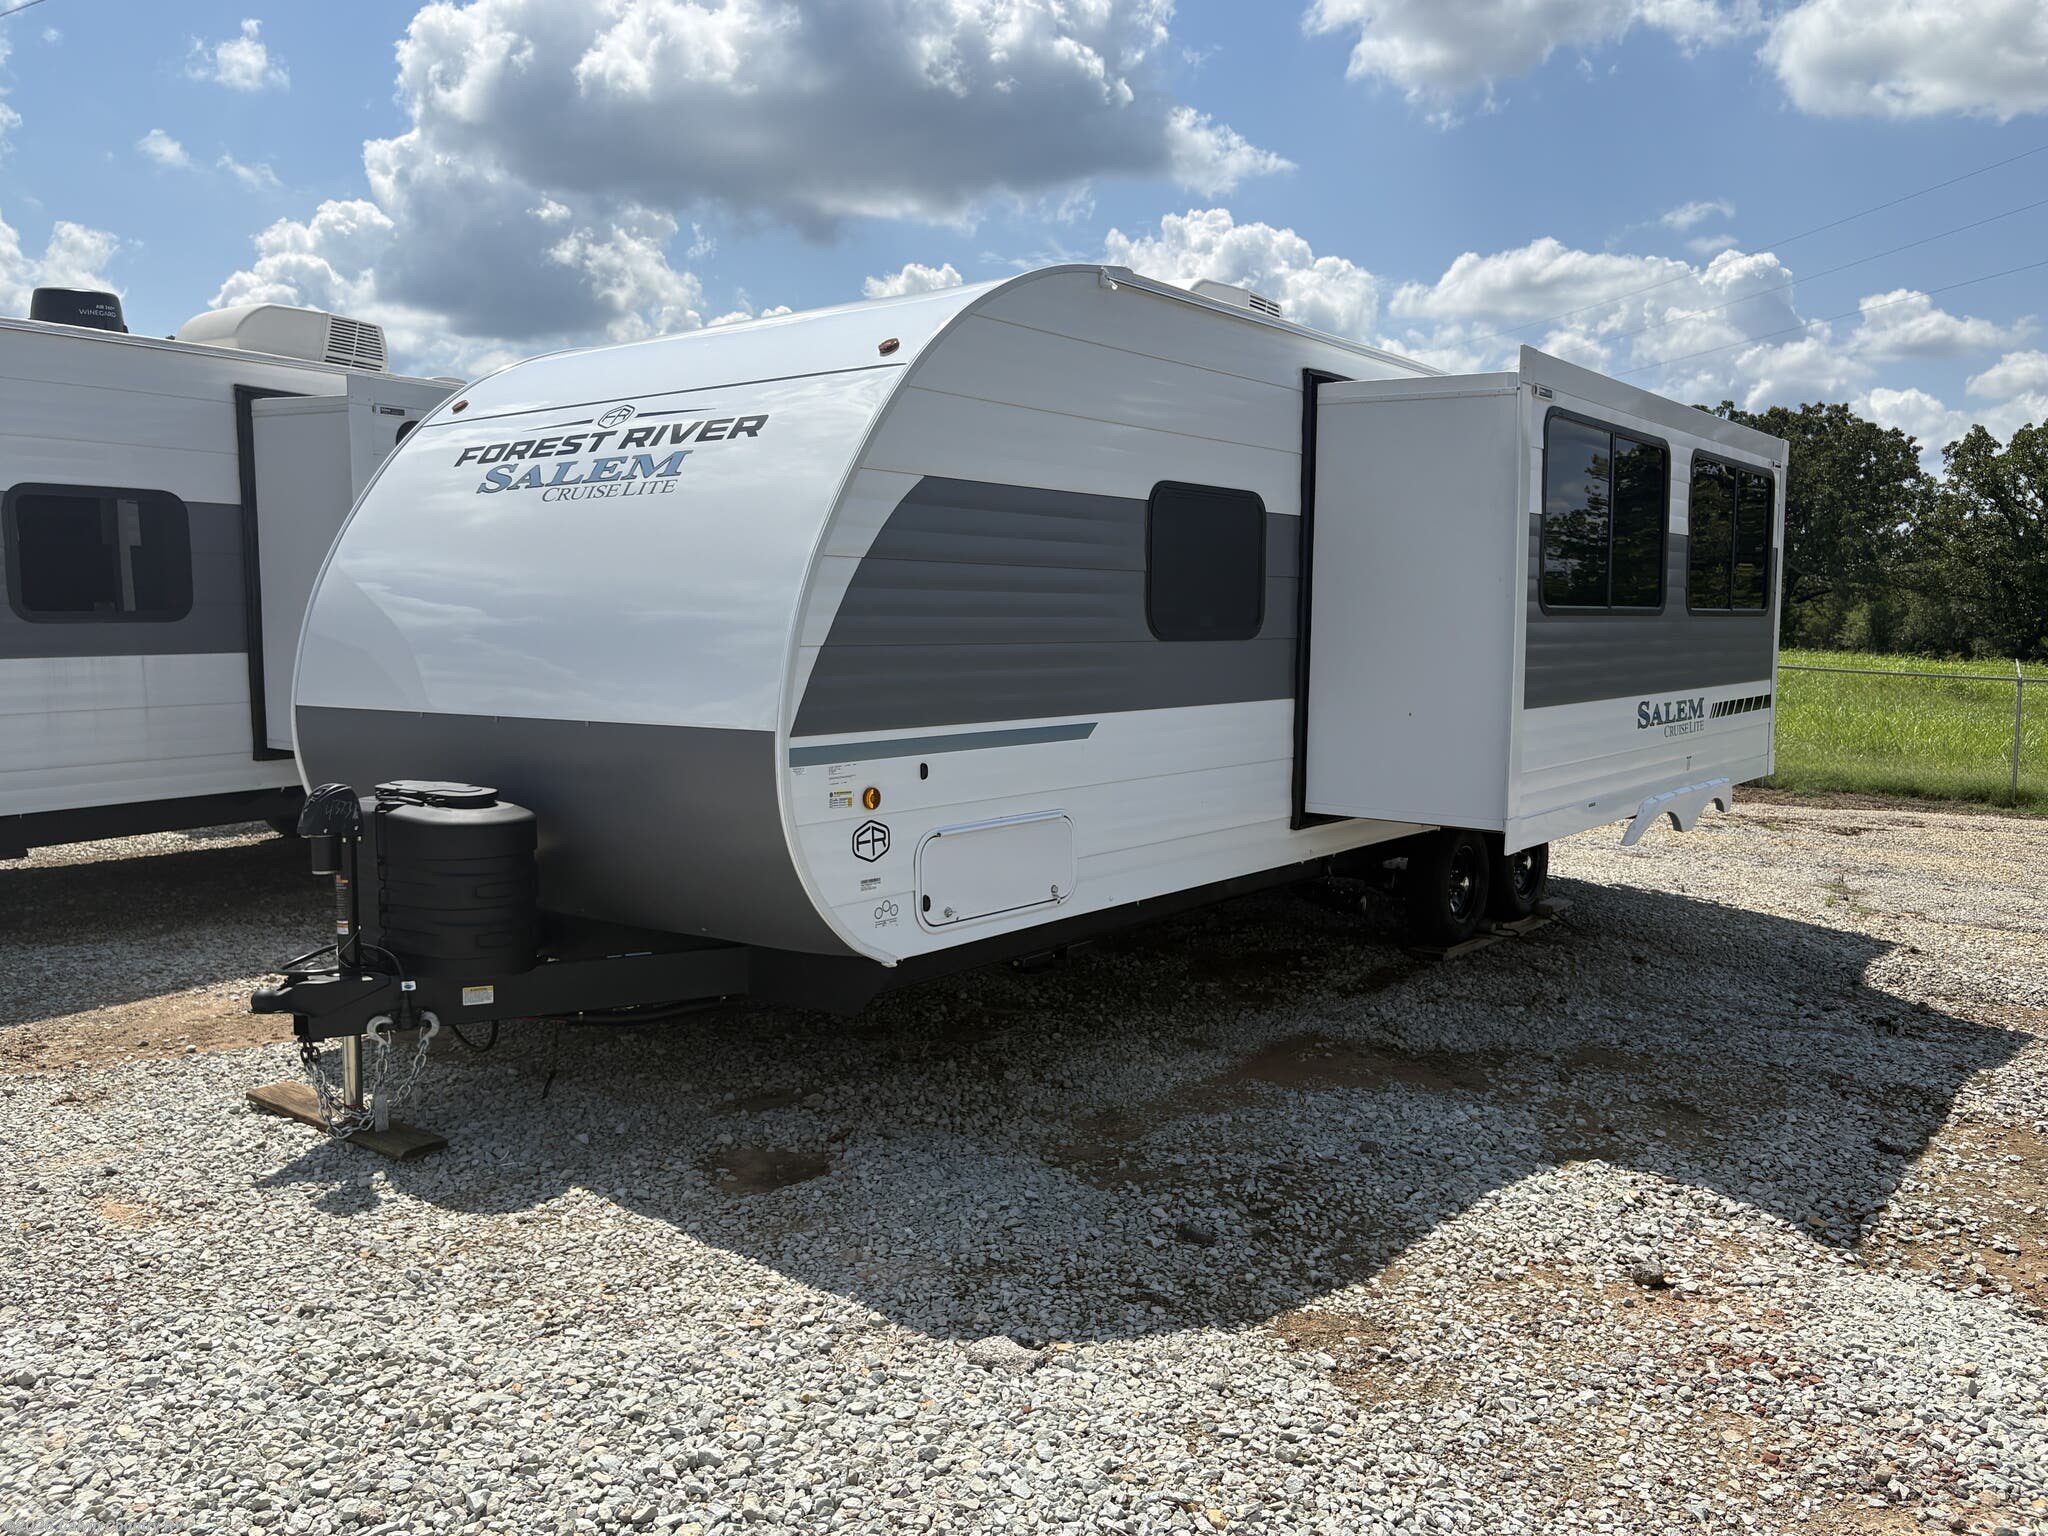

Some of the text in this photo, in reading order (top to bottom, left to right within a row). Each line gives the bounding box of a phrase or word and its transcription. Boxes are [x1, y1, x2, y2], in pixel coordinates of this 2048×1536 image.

[78, 308, 117, 318] WINEGARD
[453, 414, 770, 468] FOREST RIVER
[476, 450, 694, 494] SALEM
[1637, 697, 1705, 730] SALEM
